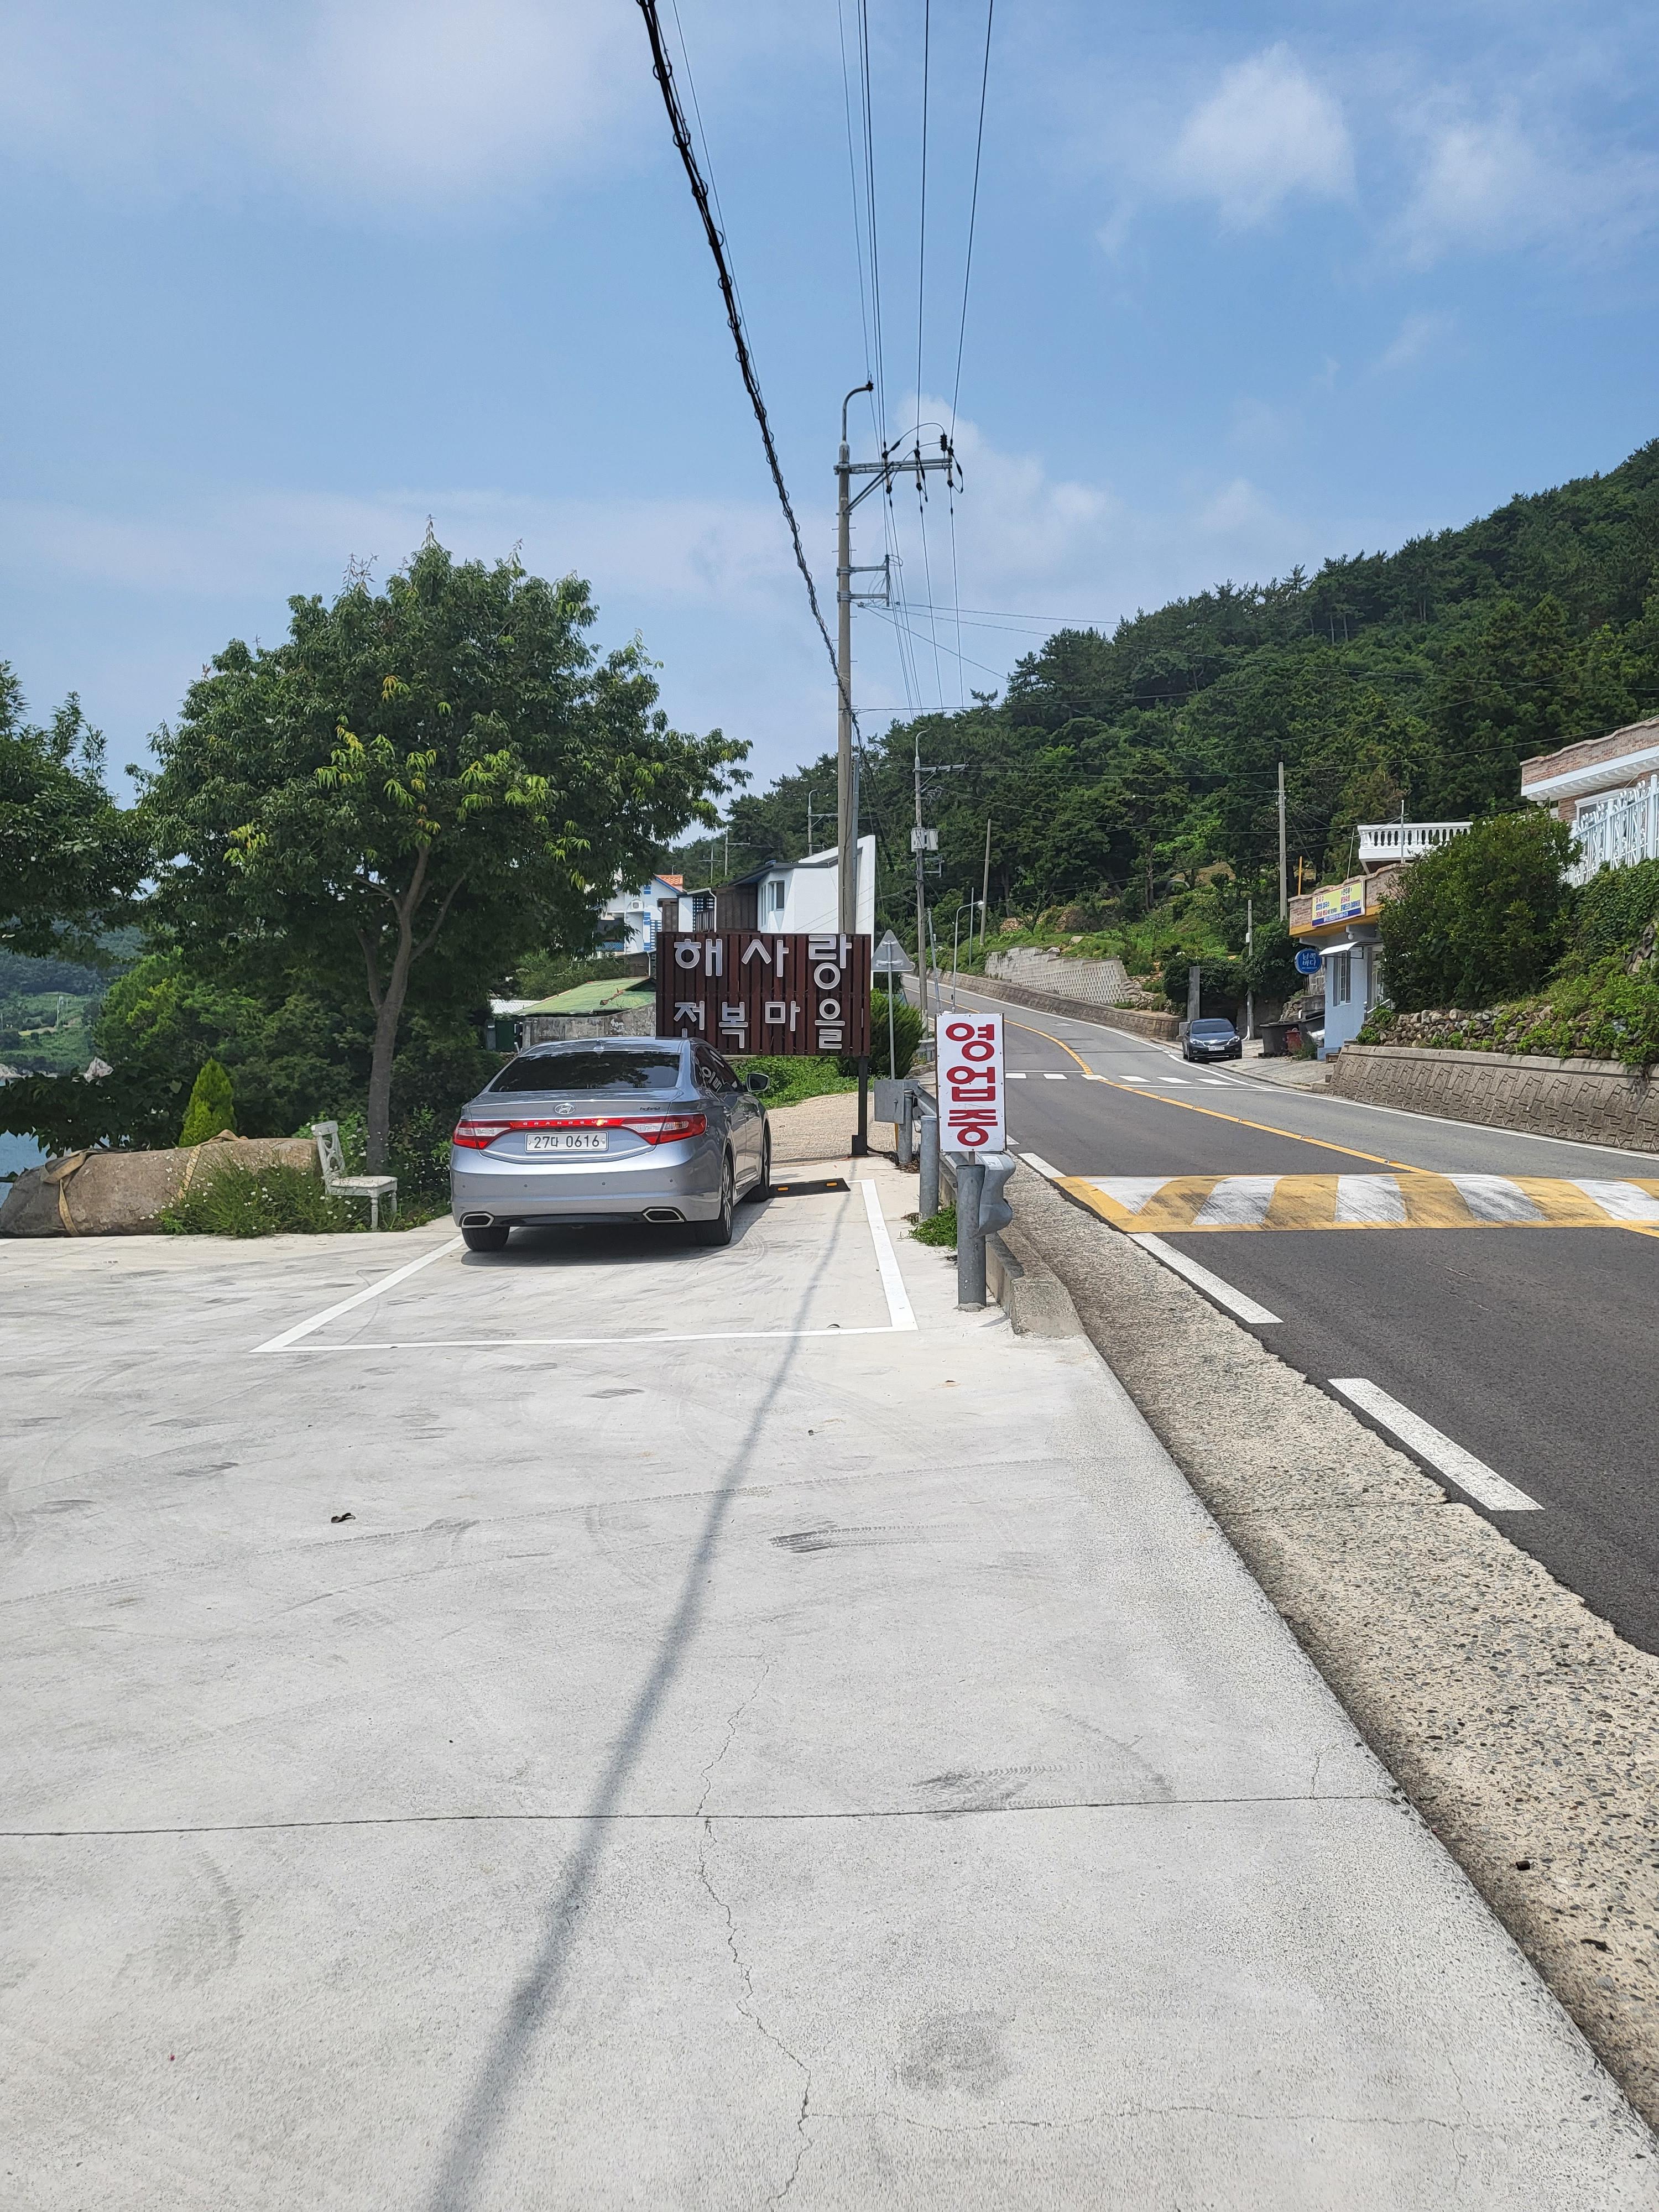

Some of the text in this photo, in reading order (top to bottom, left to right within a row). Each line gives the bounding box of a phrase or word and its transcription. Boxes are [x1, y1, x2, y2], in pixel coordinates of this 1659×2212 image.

[674, 934, 852, 990] 해사랑
[673, 998, 846, 1049] 전복마을
[945, 1022, 998, 1146] 영업중
[534, 1135, 600, 1149] 27다 0616
